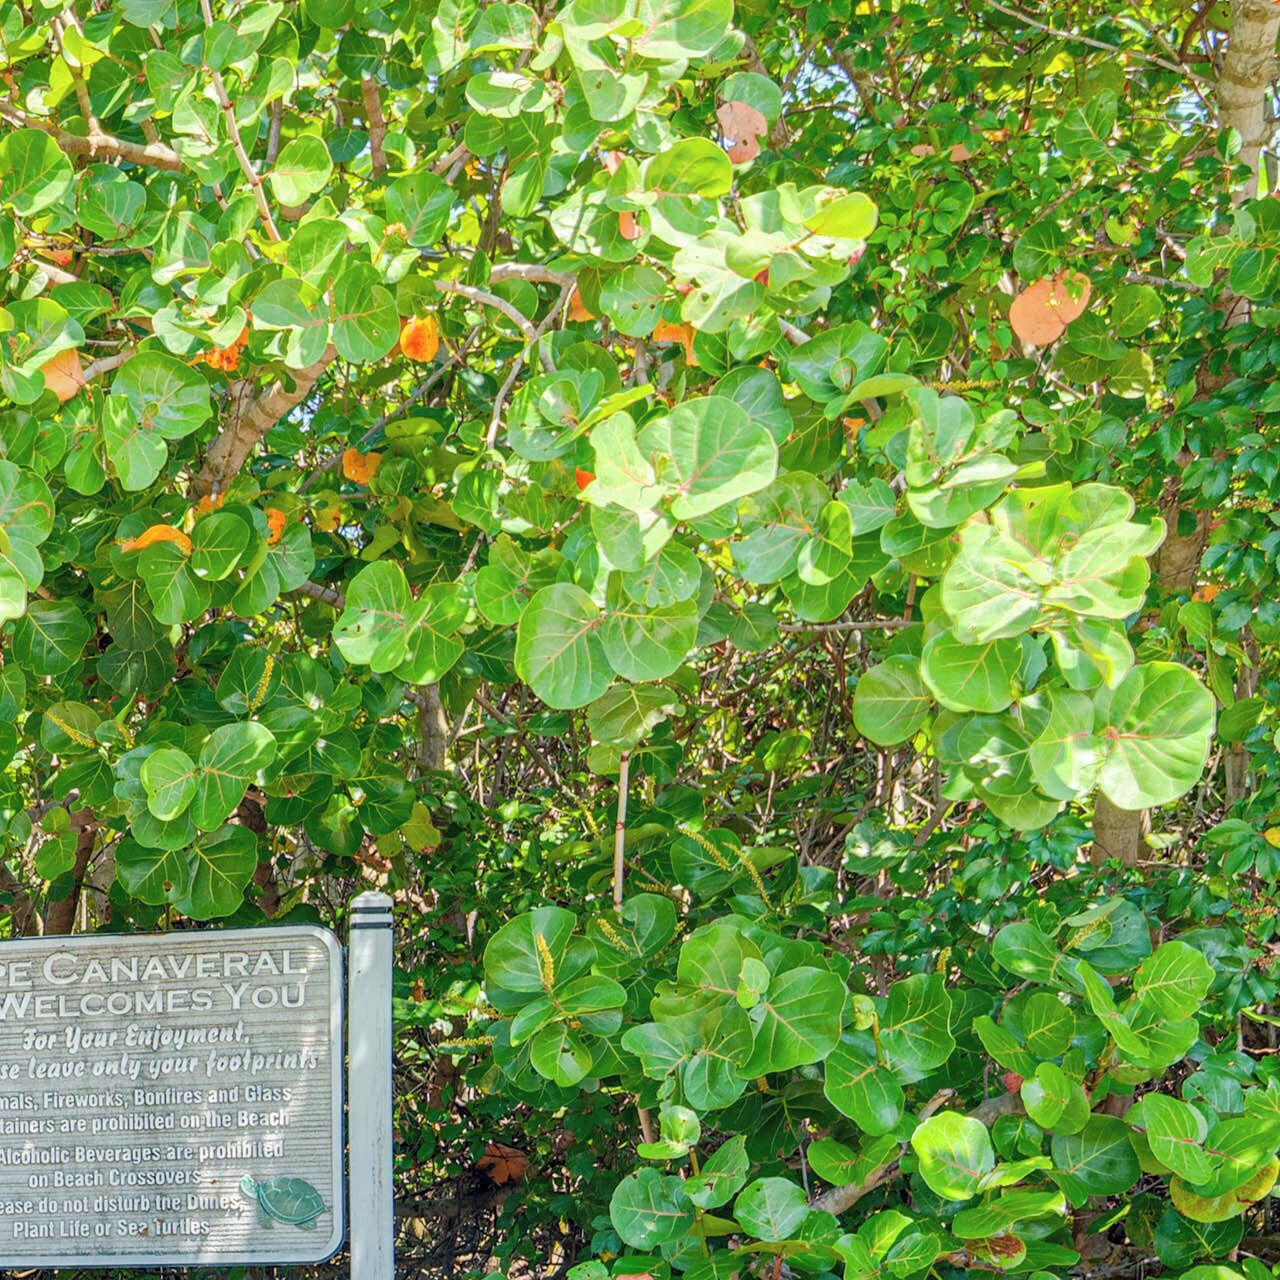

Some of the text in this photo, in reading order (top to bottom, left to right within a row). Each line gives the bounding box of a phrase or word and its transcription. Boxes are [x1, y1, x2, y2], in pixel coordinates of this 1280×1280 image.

[43, 949, 309, 985] CANAVERAL
[222, 979, 308, 1011] YOU
[23, 1020, 250, 1054] For Your Enjoyment,
[28, 1055, 84, 1079] leave
[91, 1053, 142, 1081] only
[149, 1055, 199, 1080] your
[206, 1048, 319, 1077] footprints
[44, 1090, 128, 1110] Fireworks,
[135, 1089, 202, 1106] Bonfires
[209, 1086, 239, 1103] and
[245, 1085, 291, 1102] Glass
[61, 1118, 86, 1133] are
[92, 1114, 174, 1135] prohibited
[180, 1114, 200, 1129] on
[204, 1111, 231, 1128] the
[238, 1109, 289, 1126] Beach
[75, 1145, 160, 1166] Beverages
[167, 1146, 193, 1160] are
[199, 1140, 284, 1162] prohibited
[29, 1168, 201, 1189] on Beach Crossovers
[39, 1197, 57, 1213] do
[63, 1197, 88, 1213] not
[94, 1194, 149, 1212] disturb
[155, 1194, 180, 1211] the
[13, 1220, 54, 1238] Plant
[60, 1219, 89, 1237] Life
[95, 1222, 111, 1236] or
